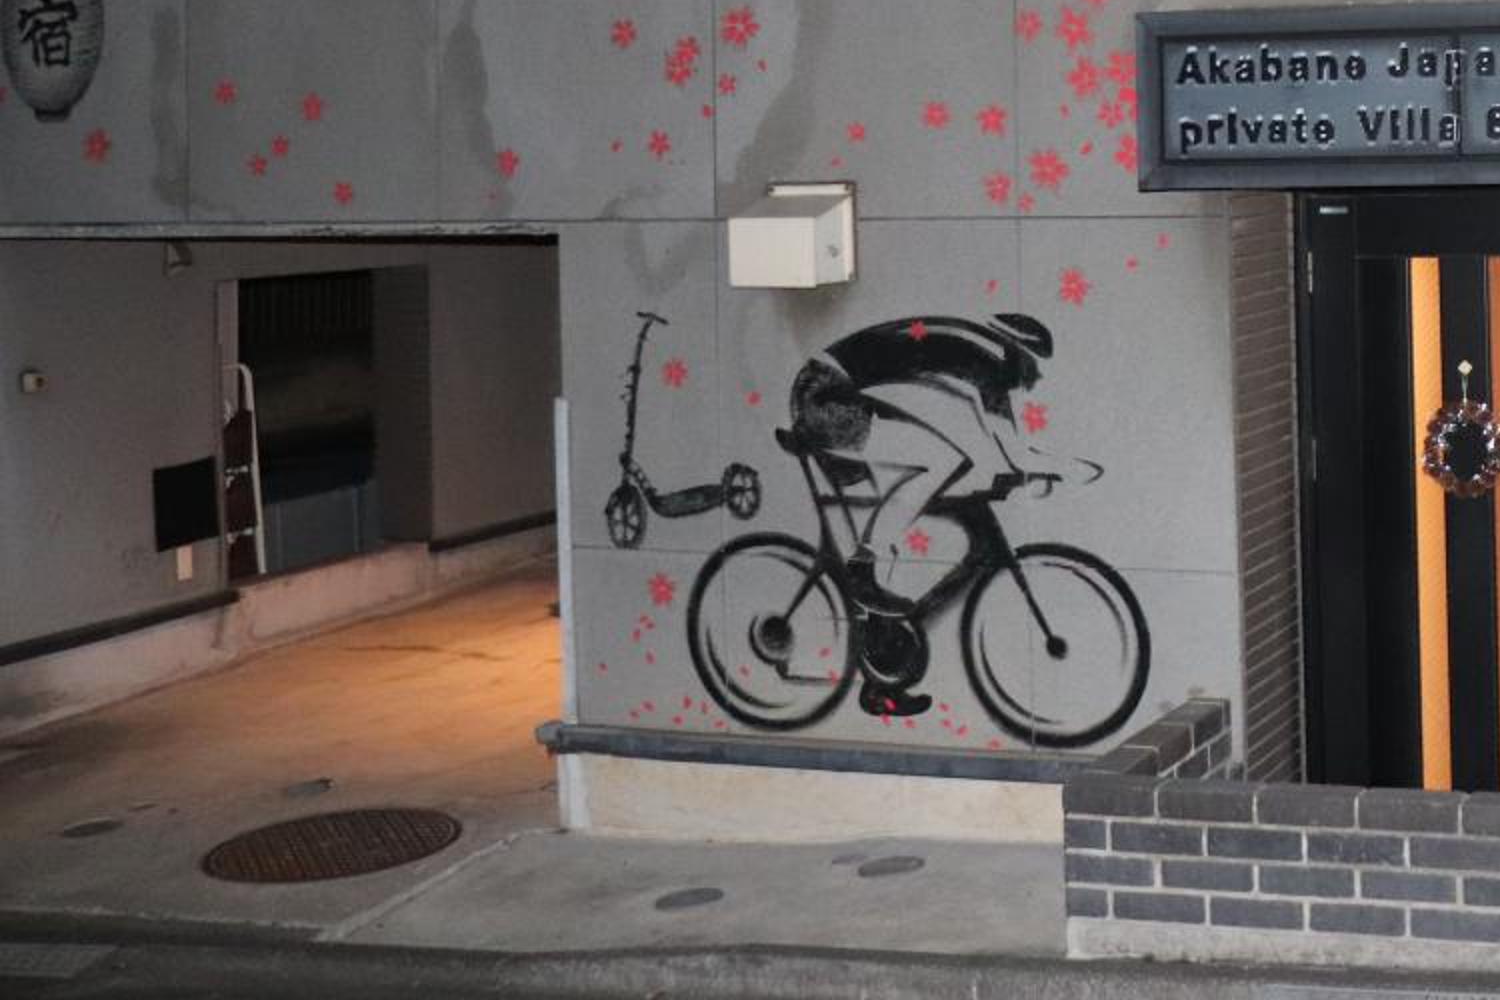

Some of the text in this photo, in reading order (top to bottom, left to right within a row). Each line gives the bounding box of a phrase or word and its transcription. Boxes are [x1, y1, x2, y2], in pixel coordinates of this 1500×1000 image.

[1176, 42, 1366, 86] Akabane
[1179, 106, 1335, 157] private
[1357, 104, 1459, 147] Villa
